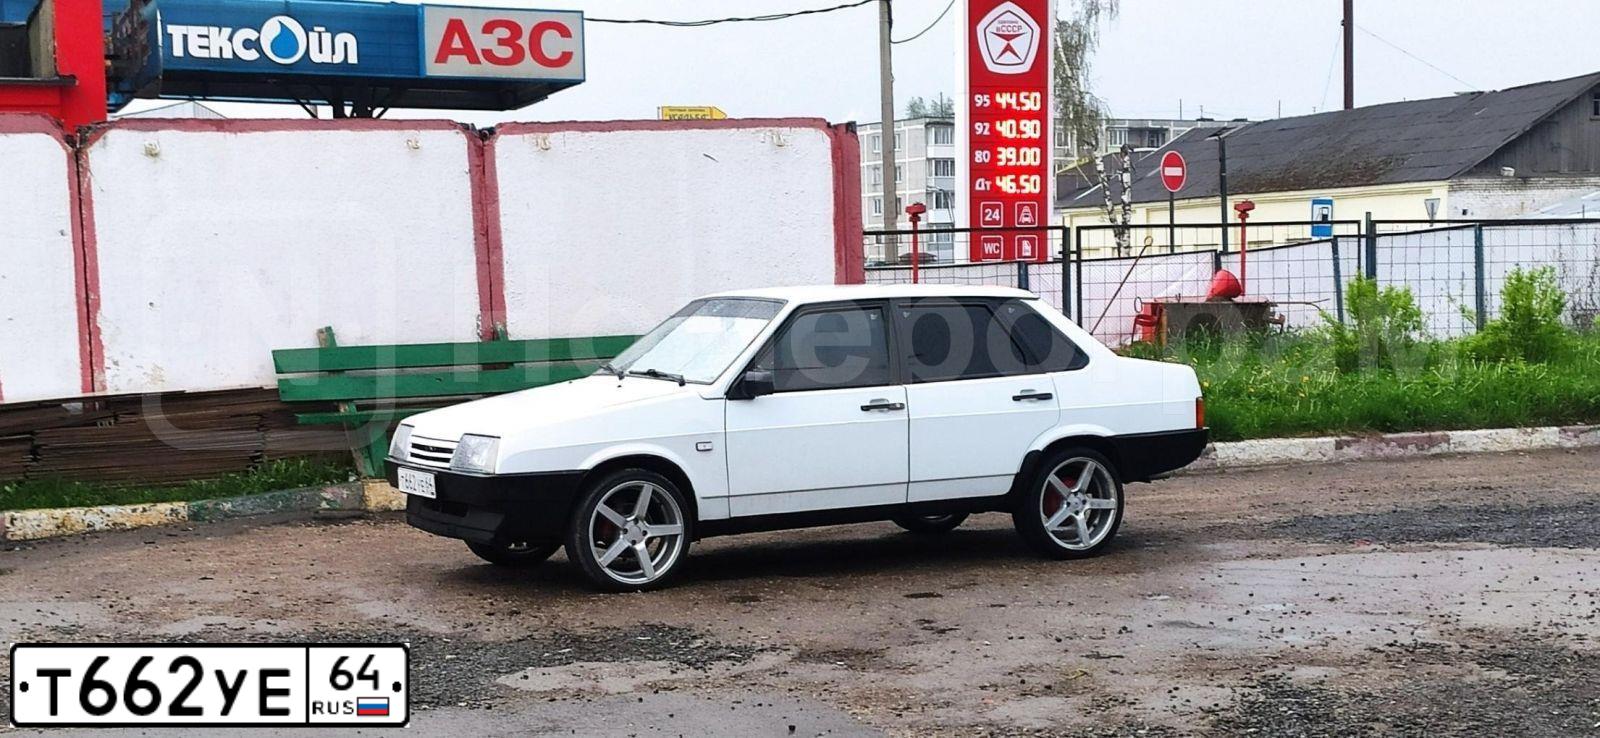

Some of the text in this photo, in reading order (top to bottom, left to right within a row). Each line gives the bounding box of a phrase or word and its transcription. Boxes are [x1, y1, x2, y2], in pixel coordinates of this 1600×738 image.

[434, 18, 574, 68] АЗС
[974, 91, 1041, 111] 95 44.50
[974, 119, 1041, 139] 92 40.90
[974, 147, 1041, 166] 80 39.00
[995, 174, 1041, 194] 46.50
[984, 208, 1000, 221] 24
[984, 242, 1000, 254] WC
